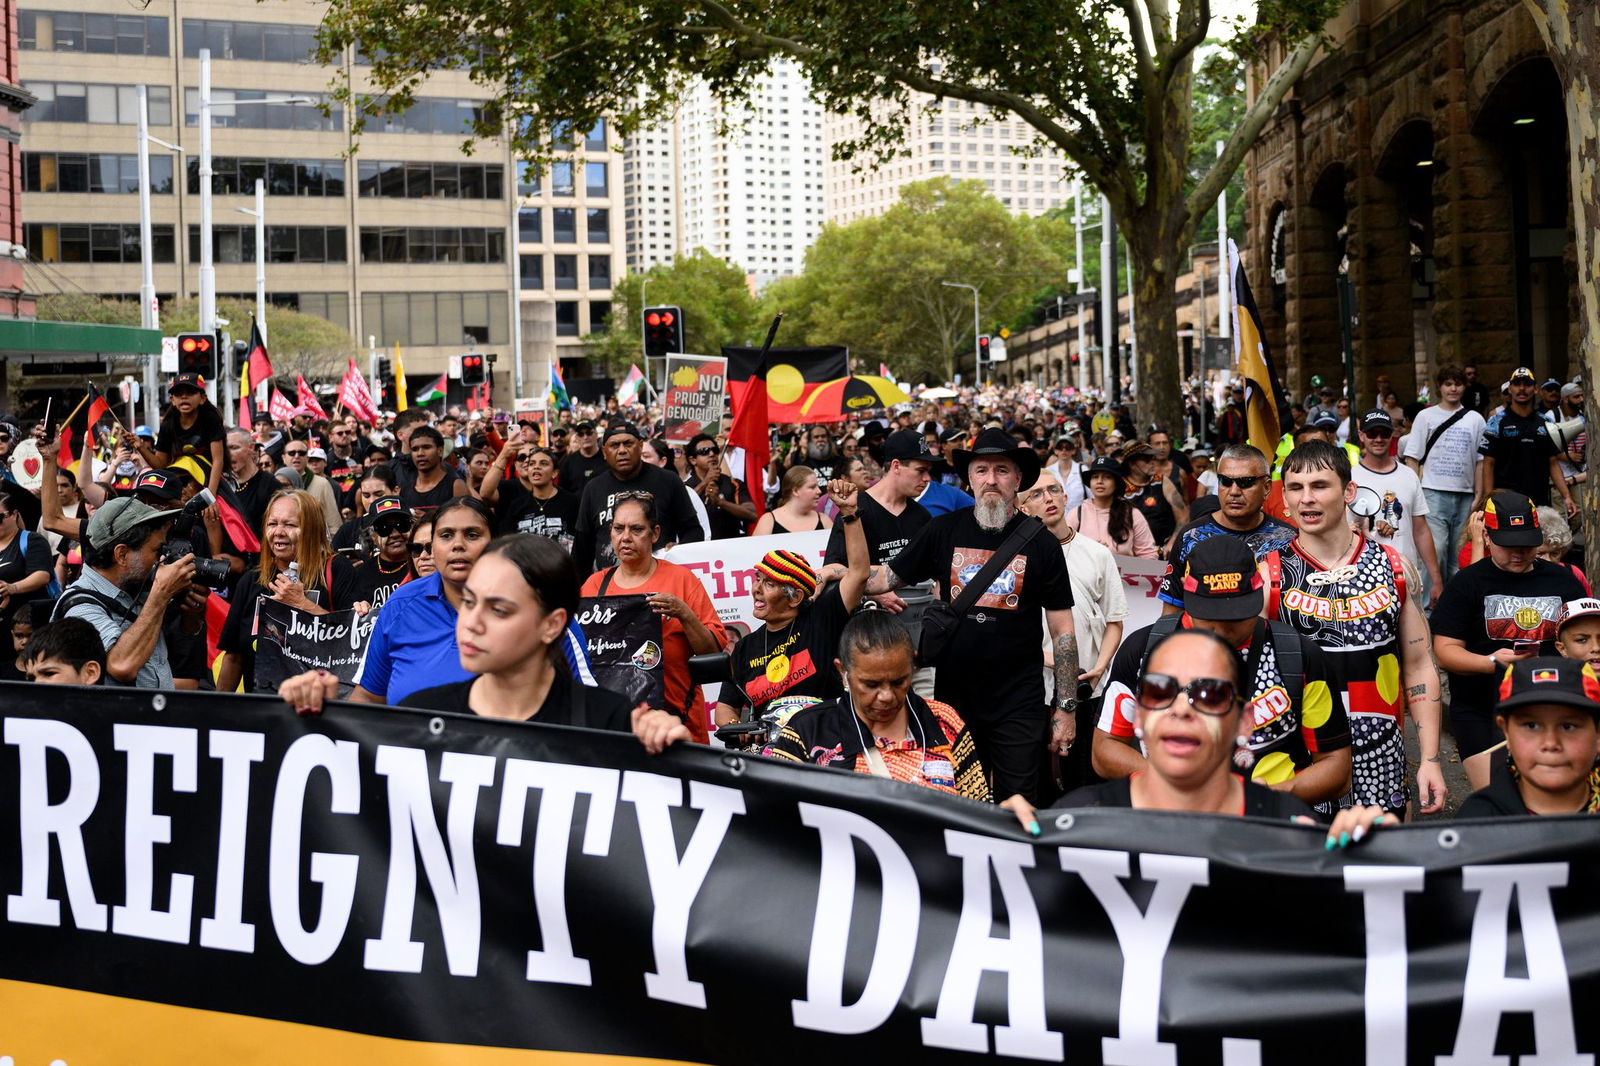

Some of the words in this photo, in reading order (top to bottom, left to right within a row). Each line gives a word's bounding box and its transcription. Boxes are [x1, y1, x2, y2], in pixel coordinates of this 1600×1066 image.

[699, 374, 722, 392] NO
[674, 391, 706, 406] PRIDE
[709, 394, 721, 407] IN
[517, 411, 544, 422] STOP
[667, 406, 719, 422] GENOCIDE
[879, 540, 901, 550] JUSTICE
[1203, 573, 1242, 585] SACRED
[1210, 580, 1239, 591] LAND
[1286, 590, 1332, 620] OUR
[1335, 586, 1392, 620] LAND
[1496, 598, 1555, 619] ABOLISH
[1516, 611, 1538, 624] THE
[287, 610, 349, 643] Justice
[597, 638, 627, 656] forever
[302, 657, 312, 665] we
[313, 656, 331, 669] stand
[751, 686, 779, 703] BLACK
[3, 717, 747, 1010] REIGNTY
